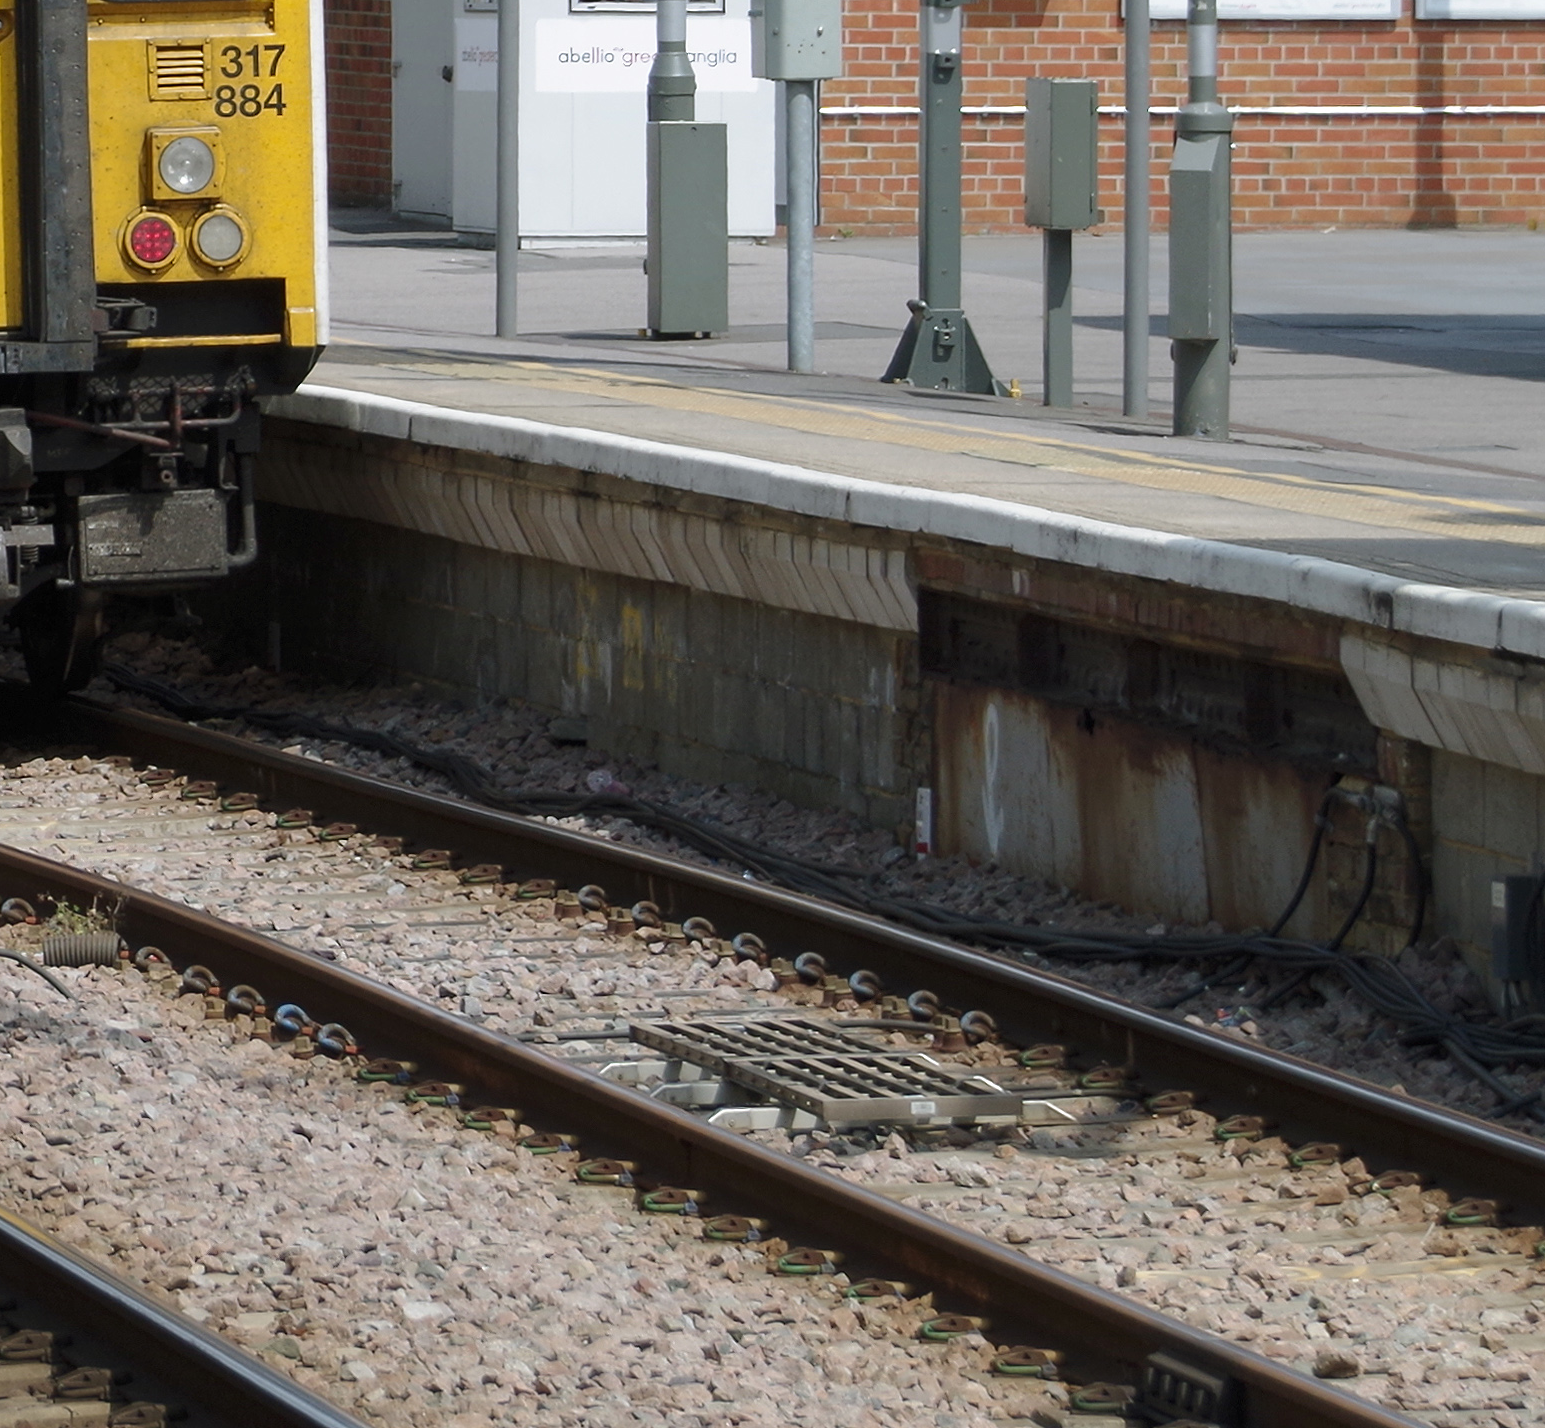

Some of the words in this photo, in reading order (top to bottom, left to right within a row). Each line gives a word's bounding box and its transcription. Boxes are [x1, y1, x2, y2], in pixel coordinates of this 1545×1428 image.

[220, 44, 286, 79] 317
[558, 47, 615, 63] abellio
[687, 47, 737, 67] anglia
[214, 83, 287, 118] 884
